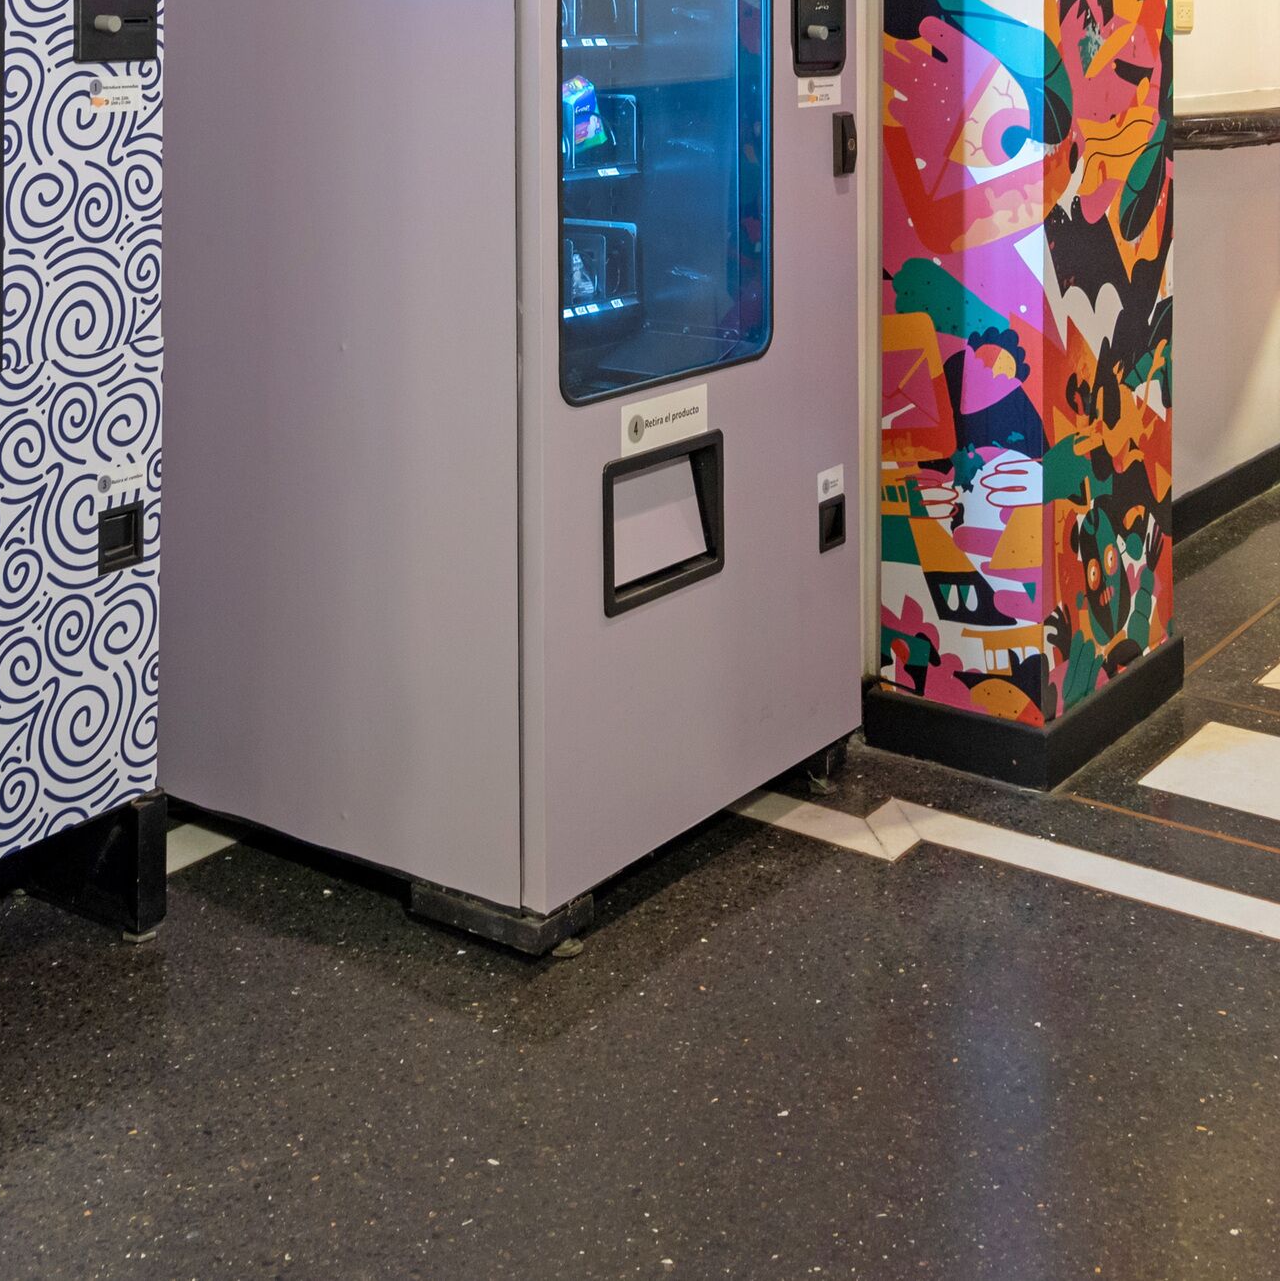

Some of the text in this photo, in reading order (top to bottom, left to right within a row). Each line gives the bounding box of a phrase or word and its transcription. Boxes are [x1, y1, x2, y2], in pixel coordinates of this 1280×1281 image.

[633, 405, 700, 436] 4 Retira el producto
